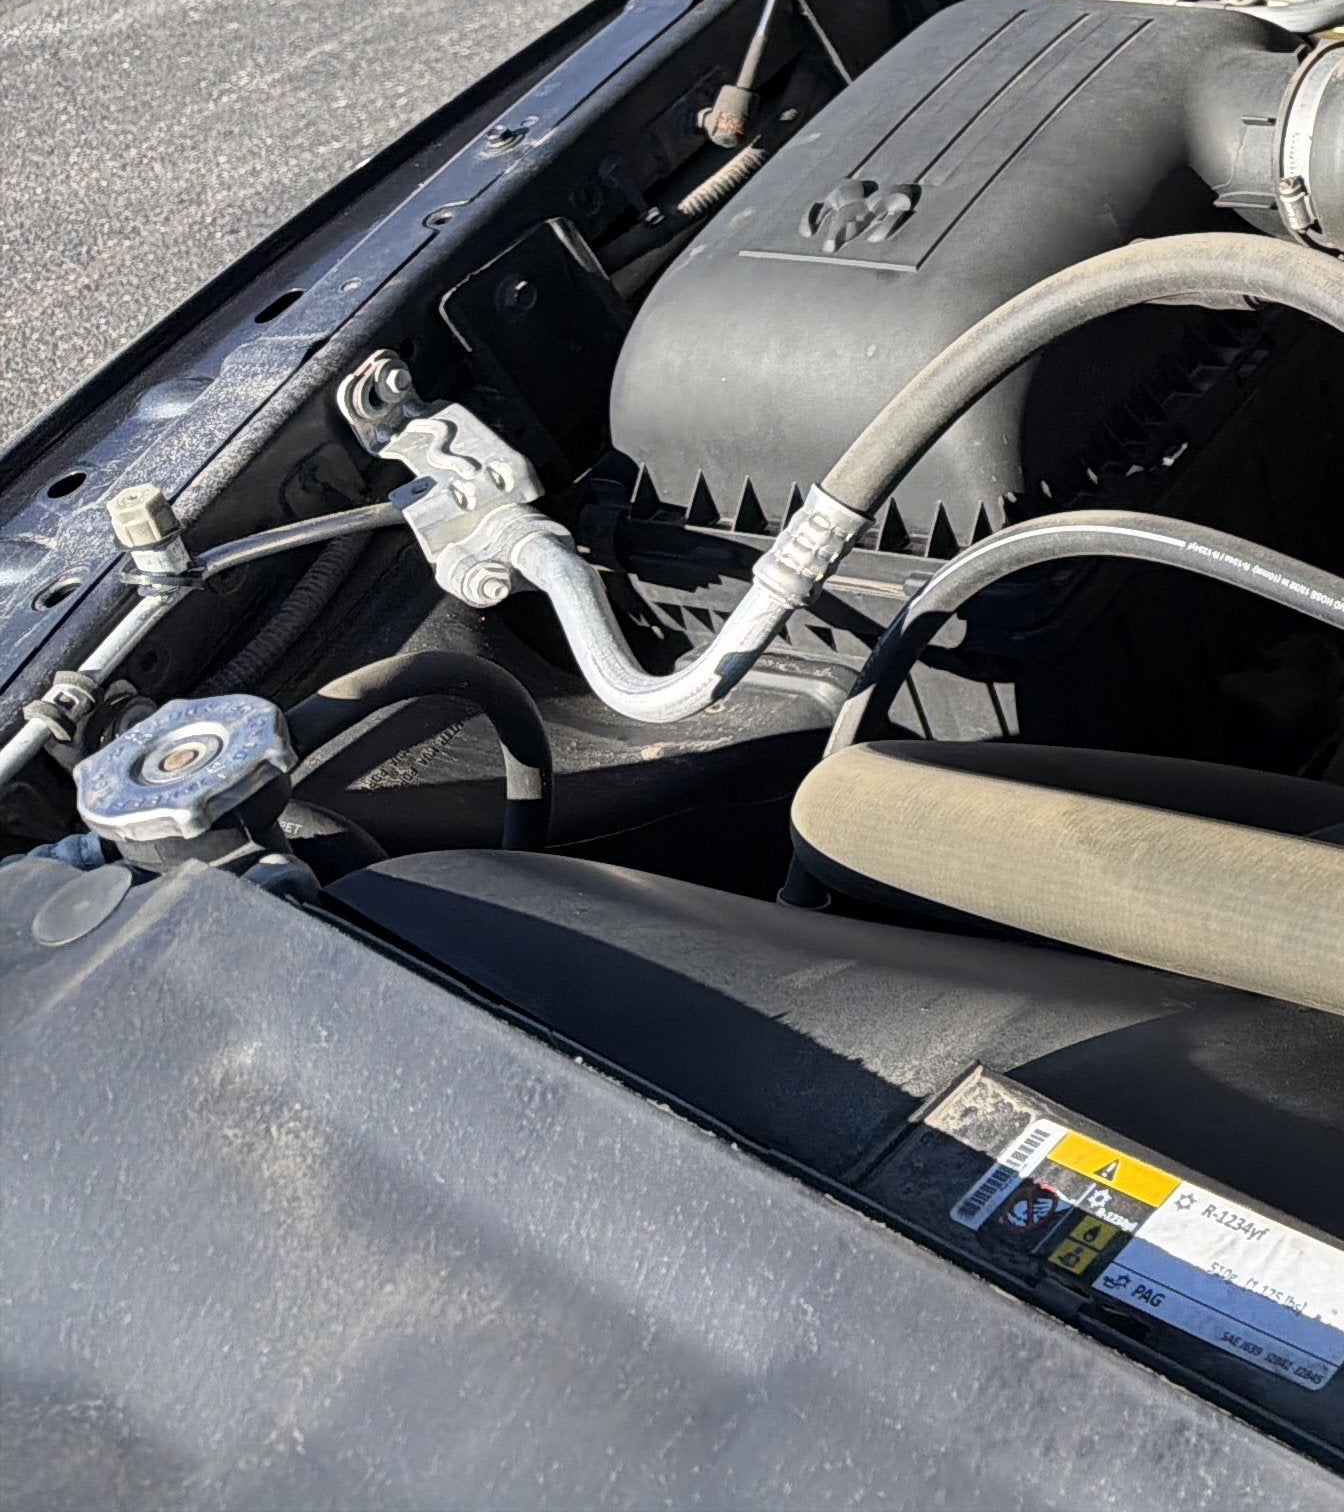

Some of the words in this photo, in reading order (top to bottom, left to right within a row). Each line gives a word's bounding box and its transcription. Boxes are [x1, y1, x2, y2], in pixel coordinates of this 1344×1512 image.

[1201, 1203, 1271, 1243] R-1234yf
[1132, 1284, 1166, 1308] PAG
[1221, 1331, 1242, 1348] SAE
